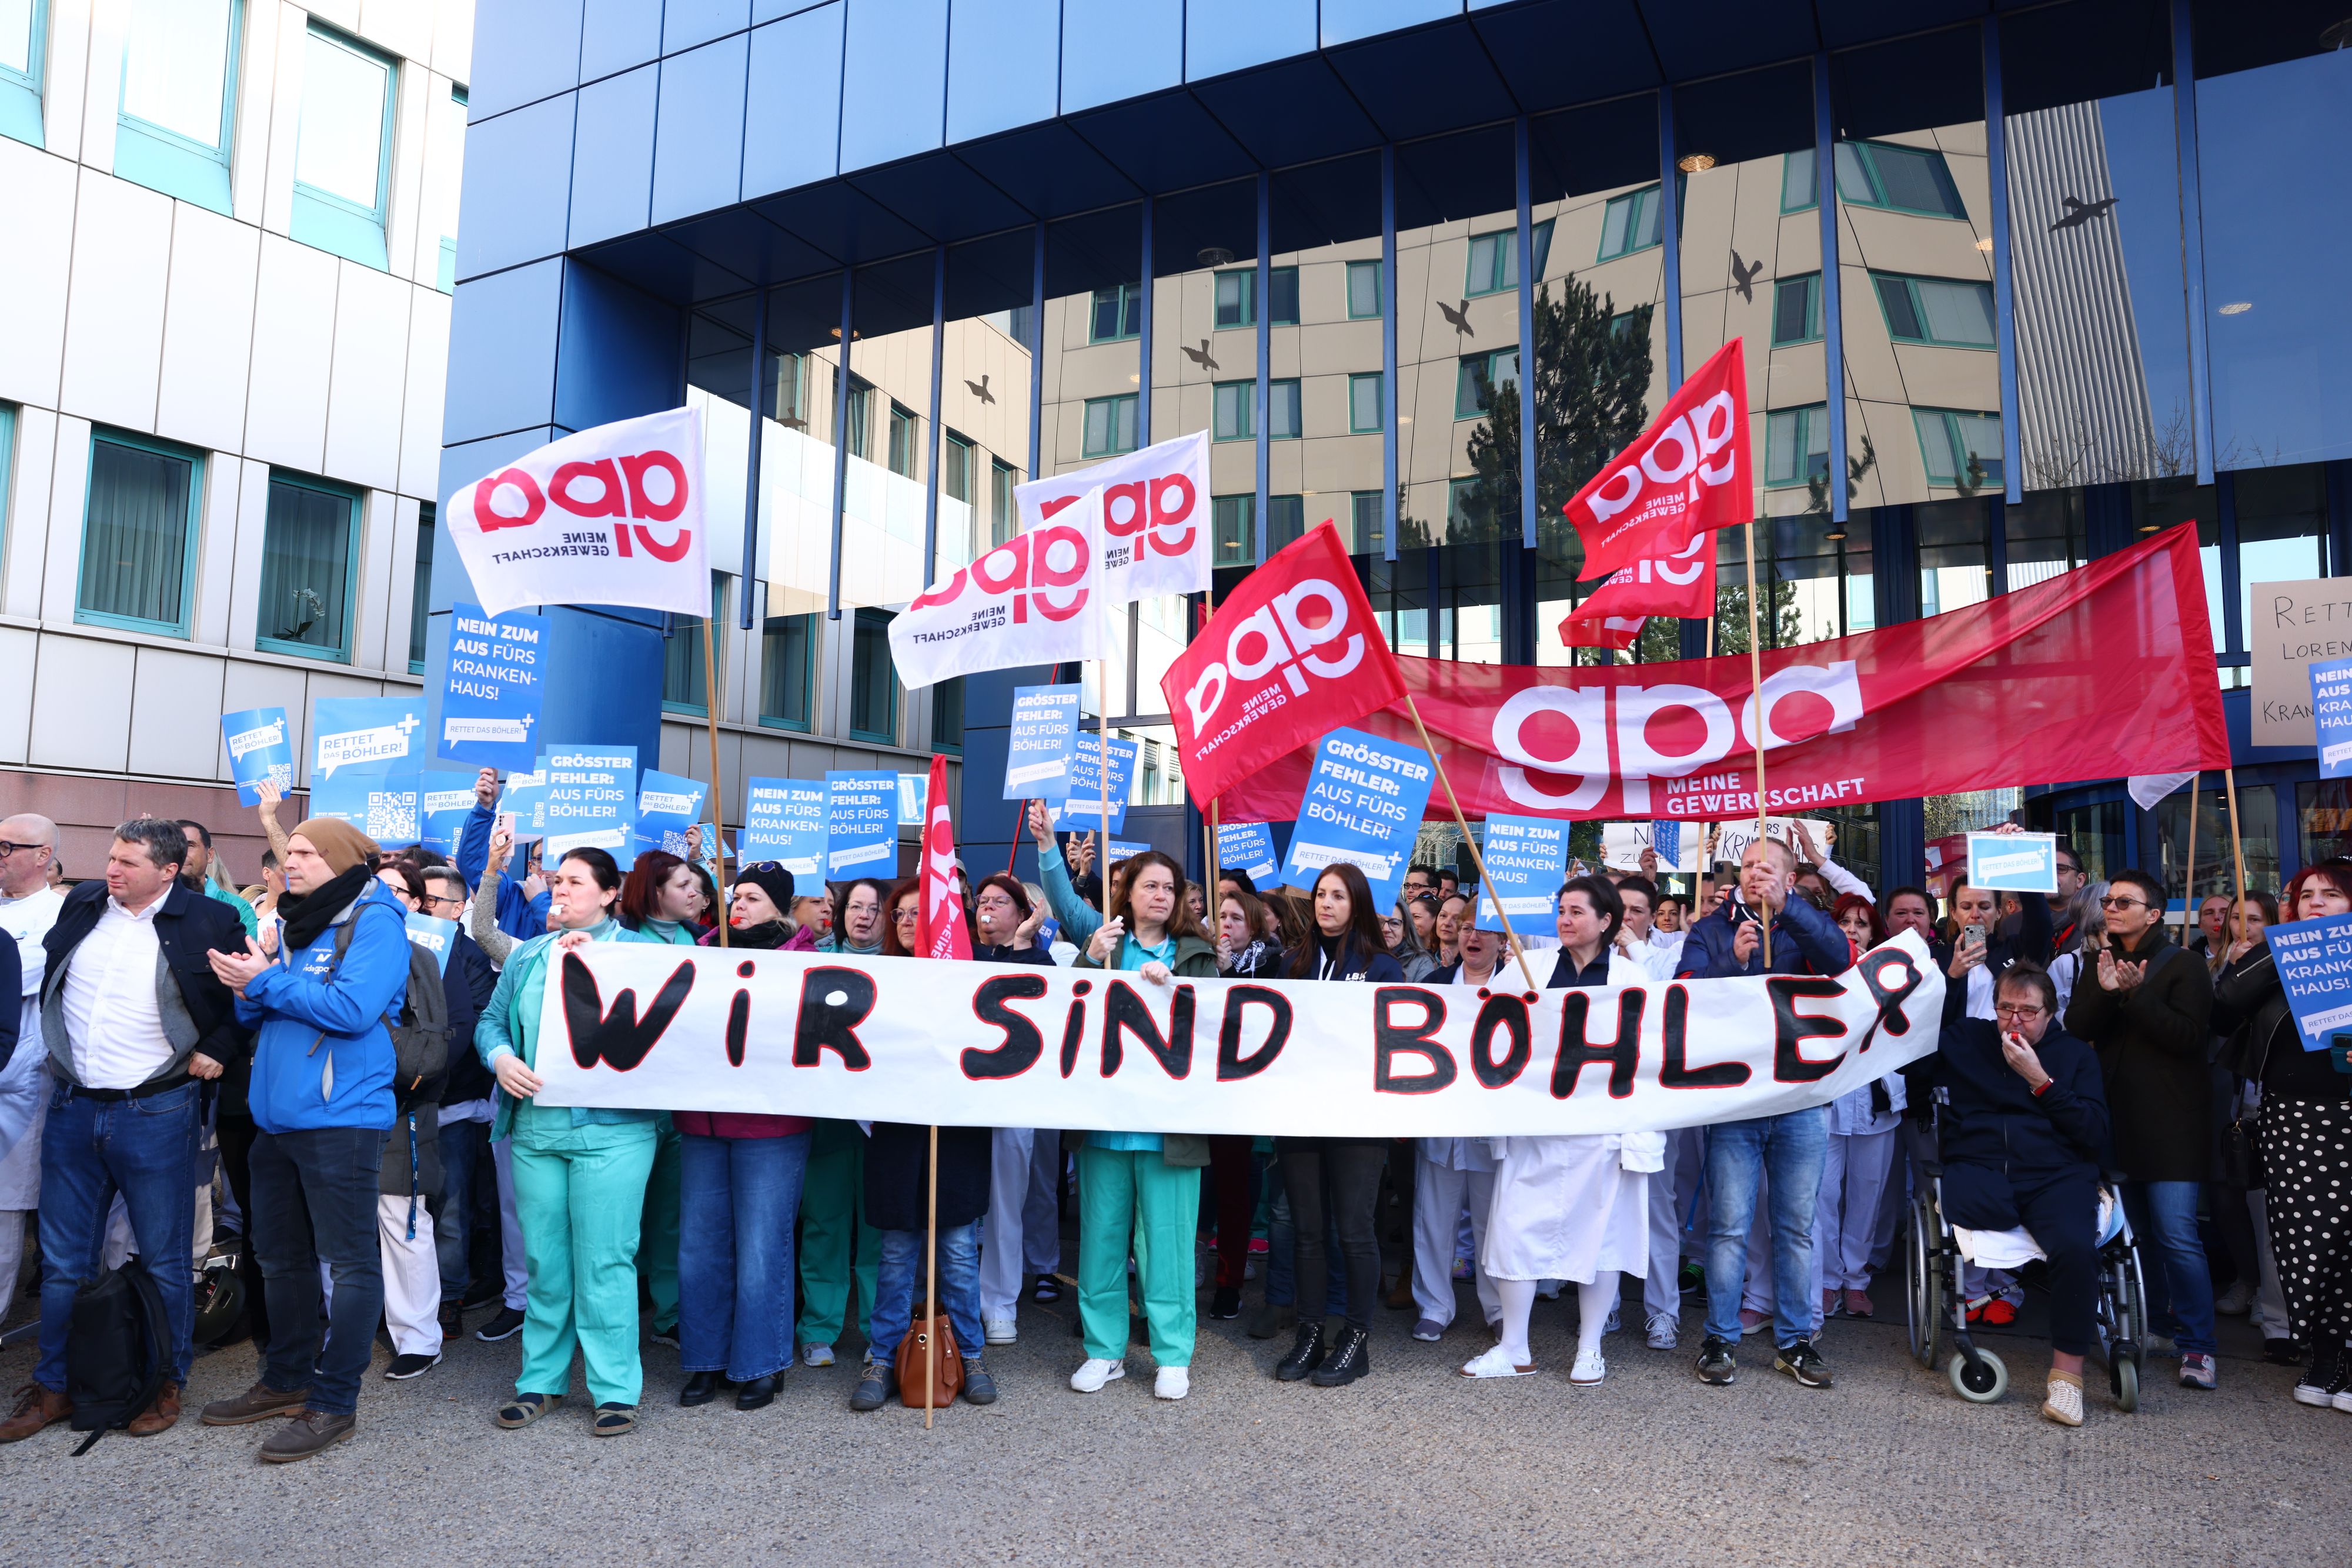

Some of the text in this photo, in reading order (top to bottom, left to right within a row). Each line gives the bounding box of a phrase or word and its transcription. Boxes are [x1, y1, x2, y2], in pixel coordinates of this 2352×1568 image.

[456, 617, 539, 644] NEIN ZUM
[453, 638, 536, 664] AUS FÜRS
[452, 658, 538, 685] KRANKEN-
[450, 679, 499, 701] HAUS!
[2317, 684, 2350, 699] AUS
[1017, 694, 1077, 707] GRÖSSTER
[1015, 710, 1063, 721] FEHLER:
[492, 726, 522, 734] BÖHLER!
[1014, 723, 1069, 736] AUS FÜRS
[1492, 659, 1864, 814] gpa
[232, 731, 263, 745] RETTET
[245, 735, 280, 750] BÖHLER!
[324, 734, 375, 750] RETTET
[1013, 739, 1061, 751] BÖHLER!
[342, 743, 402, 760] BÖHLER!
[1077, 740, 1134, 759] GRÖSTER
[550, 753, 633, 768] GRÖSSTER
[1075, 753, 1120, 768] FEHLR:
[1327, 739, 1429, 782] GRÖSSTER
[1073, 765, 1094, 776] AUS
[550, 772, 615, 784] FEHLER:
[831, 778, 894, 791] GRÖSSTER
[1071, 776, 1117, 793] BÖHLR!
[1319, 760, 1401, 797] FEHLER:
[1666, 771, 1741, 795] MEINE
[549, 787, 624, 801] AUS FÜRS
[644, 794, 674, 803] RETTET
[753, 788, 823, 802] NEIN ZUM
[830, 795, 881, 805] FEHLER:
[653, 802, 689, 812] BÖHLER!
[1312, 782, 1408, 821] AUS FÜRS
[549, 803, 616, 817] BÖHLER!
[751, 803, 821, 817] AUS FÜRS
[830, 807, 889, 820] AUS FÜRS
[751, 818, 824, 832] KRANKEN-
[1307, 802, 1392, 840] BÖHLER!
[1753, 821, 1780, 834] FRS
[830, 823, 883, 834] BÖHLER!
[1490, 824, 1560, 840] NEIN ZUM
[592, 835, 620, 844] BÖHLER!
[750, 833, 792, 845] HAUS!
[1218, 830, 1257, 844] FEHLER:
[1221, 838, 1265, 854] AUS FÜRS
[1488, 840, 1558, 855] AUS FÜRS
[833, 854, 852, 862] RETTET
[864, 848, 886, 857] BÖHLER!
[1223, 850, 1264, 864] BÖHLER!
[1299, 851, 1330, 862] RETTET
[1331, 856, 1348, 865] DAS
[1487, 854, 1560, 871] KRANKEN-
[1982, 862, 2002, 871] RETTET
[2016, 858, 2040, 867] BÖHLER!
[1486, 870, 1528, 884] HAUS!
[2274, 930, 2323, 947] NEIN
[2281, 947, 2321, 964] AUS
[2291, 978, 2351, 997] HAUS!
[1373, 947, 1924, 1100] BÖHLER
[2308, 1015, 2337, 1028] RETTET
